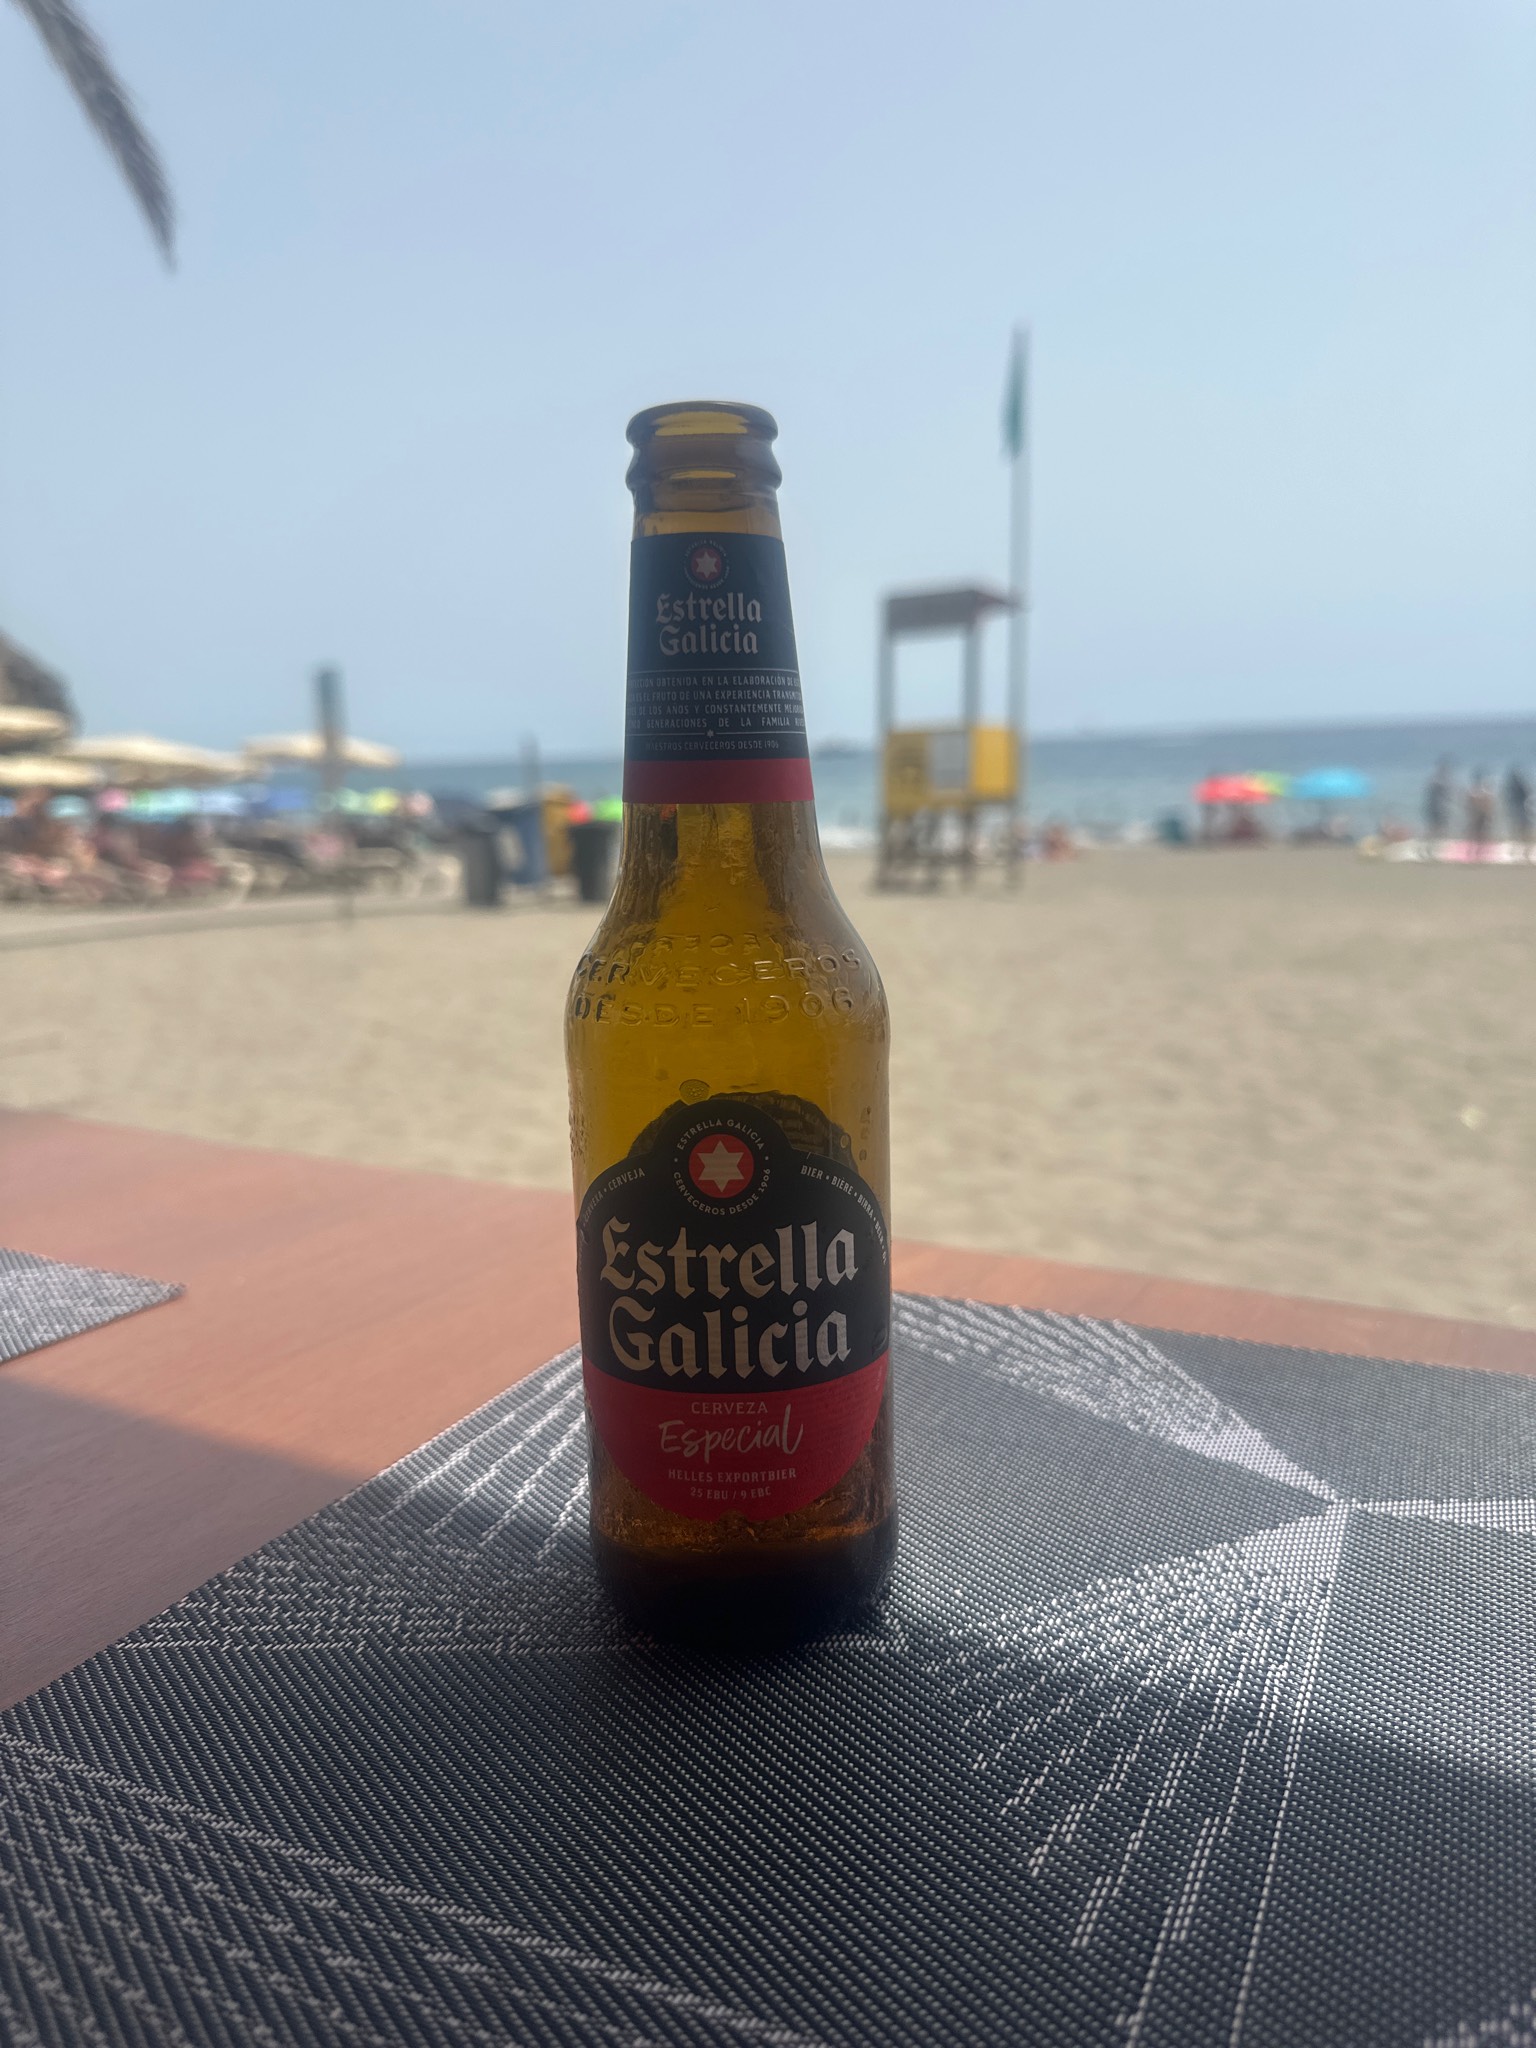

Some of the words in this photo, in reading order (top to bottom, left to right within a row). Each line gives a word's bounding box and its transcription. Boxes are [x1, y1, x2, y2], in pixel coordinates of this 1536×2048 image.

[656, 592, 762, 624] Estrella
[659, 623, 758, 656] Galicia
[652, 691, 677, 701] FRUTO
[679, 691, 690, 701] DE
[693, 690, 712, 700] UNA
[715, 690, 771, 700] EXPERIENCIA
[656, 676, 698, 687] OBTENIDA
[702, 676, 714, 686] EN
[717, 675, 729, 686] LA
[732, 674, 786, 686] ELABORACIÓN
[646, 718, 707, 729] GENERACIONES
[718, 717, 730, 728] DE
[740, 717, 752, 727] LA
[761, 716, 791, 727] FAMILIA
[649, 705, 662, 715] LOS
[694, 704, 700, 714] Y
[704, 703, 782, 714] CONSTANTEMENTE
[684, 740, 736, 751] CERVECEROS
[737, 740, 763, 750] DESDE
[576, 948, 862, 986] CERVECEROS
[574, 992, 715, 1028] DESDE
[735, 986, 856, 1025] 1906
[677, 1118, 723, 1150] ESTRELLA
[726, 1119, 765, 1150] GALICIA
[607, 1167, 646, 1192] CERVEJA
[673, 1171, 726, 1215] CERVECEROS
[729, 1193, 760, 1215] DESDE
[758, 1168, 771, 1193] 1906
[800, 1164, 824, 1180] BIER
[831, 1177, 854, 1195] BIÈRE
[857, 1193, 875, 1219] BIRRA
[600, 1215, 859, 1299] Estrella
[609, 1295, 851, 1379] Galicia
[691, 1401, 768, 1415] CERVEZA
[658, 1403, 803, 1464] Especial
[668, 1468, 713, 1483] HELLES
[717, 1467, 797, 1483] EXPORTBIER
[690, 1486, 703, 1498] 25
[706, 1489, 728, 1500] EBU
[740, 1489, 747, 1500] 9
[750, 1486, 772, 1499] EBC
